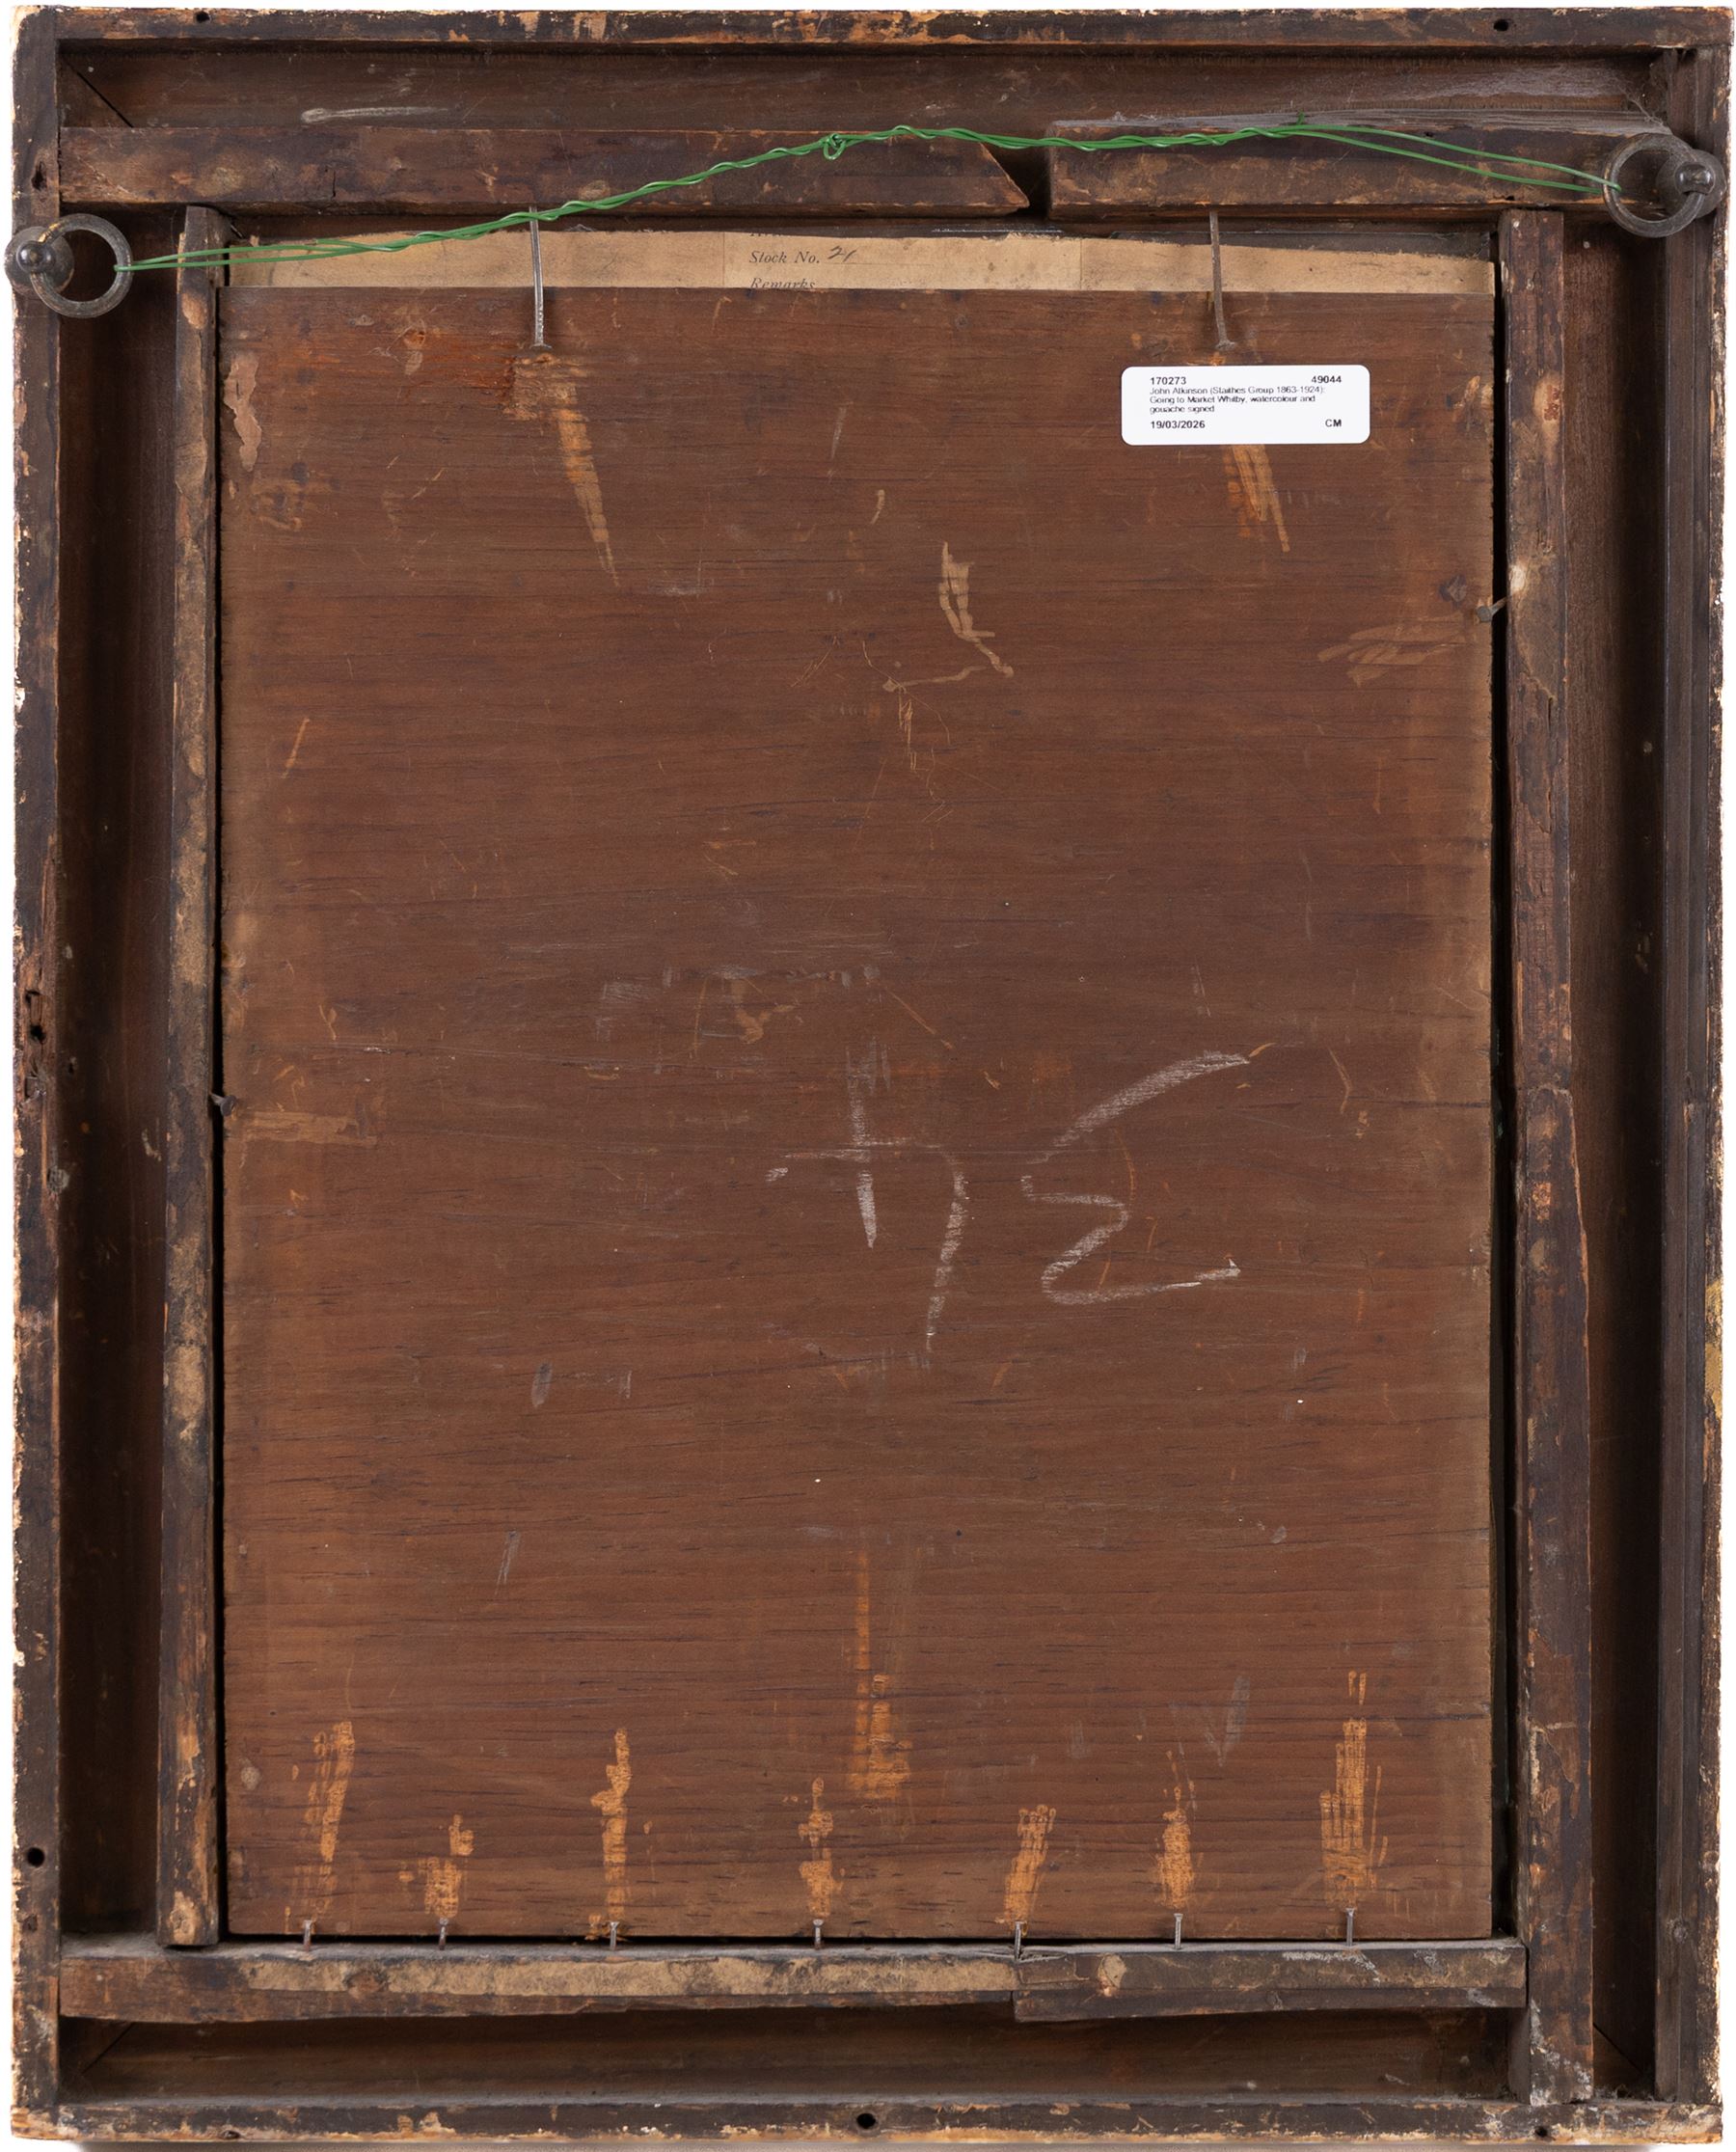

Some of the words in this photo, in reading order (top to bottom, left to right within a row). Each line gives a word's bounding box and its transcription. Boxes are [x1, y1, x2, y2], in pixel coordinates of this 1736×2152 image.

[749, 250, 787, 263] Stock
[794, 251, 820, 263] No.
[1150, 376, 1187, 386] 170273
[1311, 375, 1343, 384] 49044
[1172, 387, 1207, 395] Atkinson
[1209, 386, 1246, 395] (Staithes
[1248, 386, 1274, 395] Group
[1150, 395, 1176, 405] Going
[1177, 395, 1185, 404] to
[1187, 395, 1215, 403] Market
[1250, 395, 1297, 403] watercolour
[1150, 406, 1185, 415] gouache
[1187, 404, 1215, 414] signed
[1150, 420, 1206, 429] 19/03/2026
[1325, 419, 1343, 427] CM
